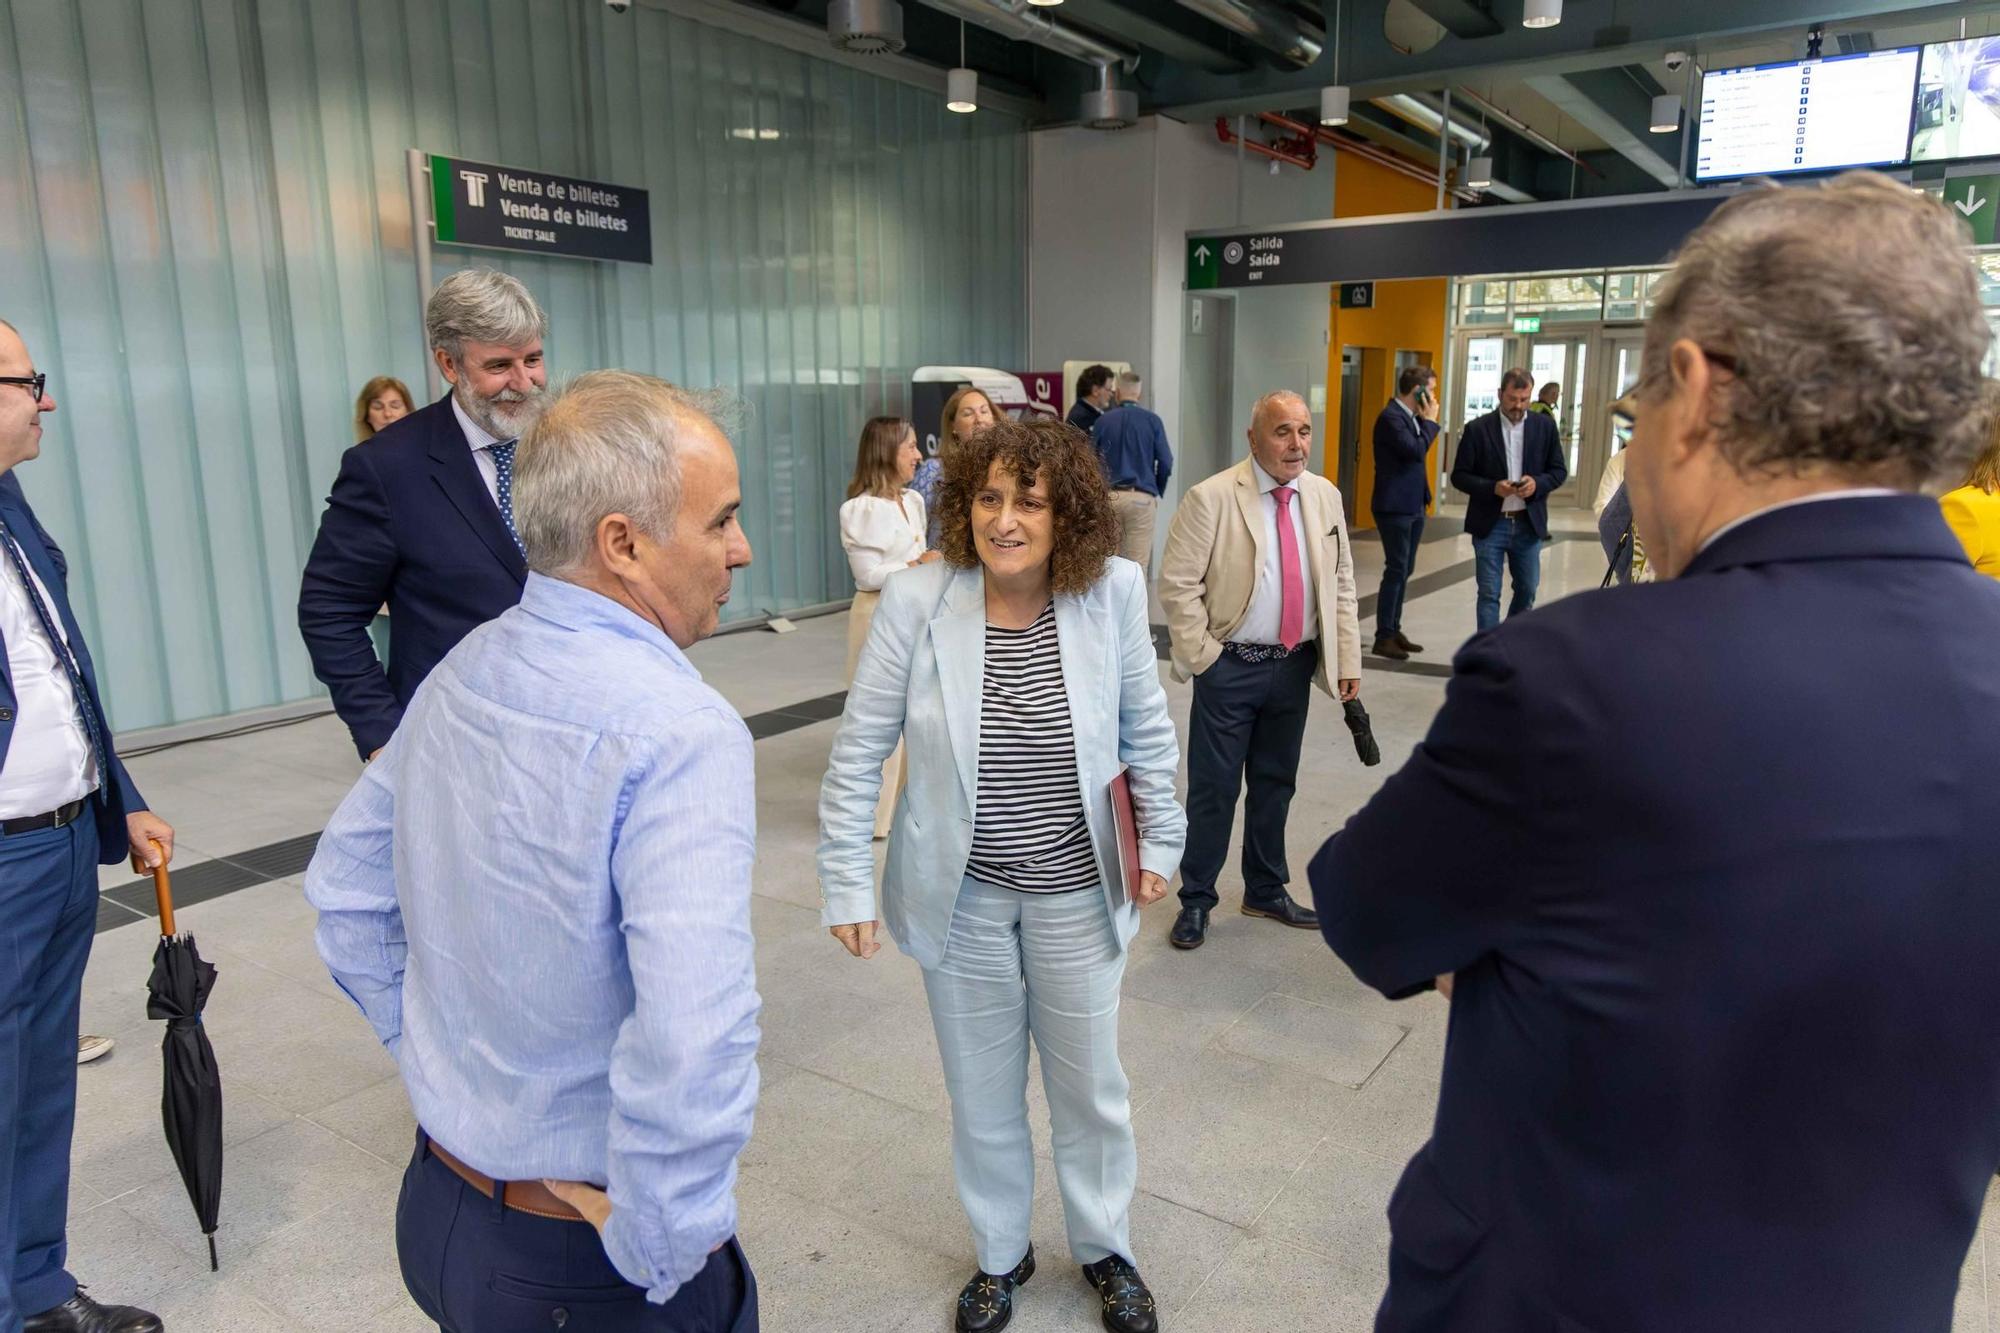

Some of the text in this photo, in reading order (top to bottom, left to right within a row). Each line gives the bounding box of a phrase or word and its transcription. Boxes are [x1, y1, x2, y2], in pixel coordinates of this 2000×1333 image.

[498, 173, 620, 208] Venta de billetes
[500, 199, 628, 232] Venda de billetes
[504, 226, 557, 243] TICKET SALE
[1250, 236, 1283, 250] Salida
[1249, 253, 1280, 266] Saída
[1249, 271, 1263, 280] EXIT
